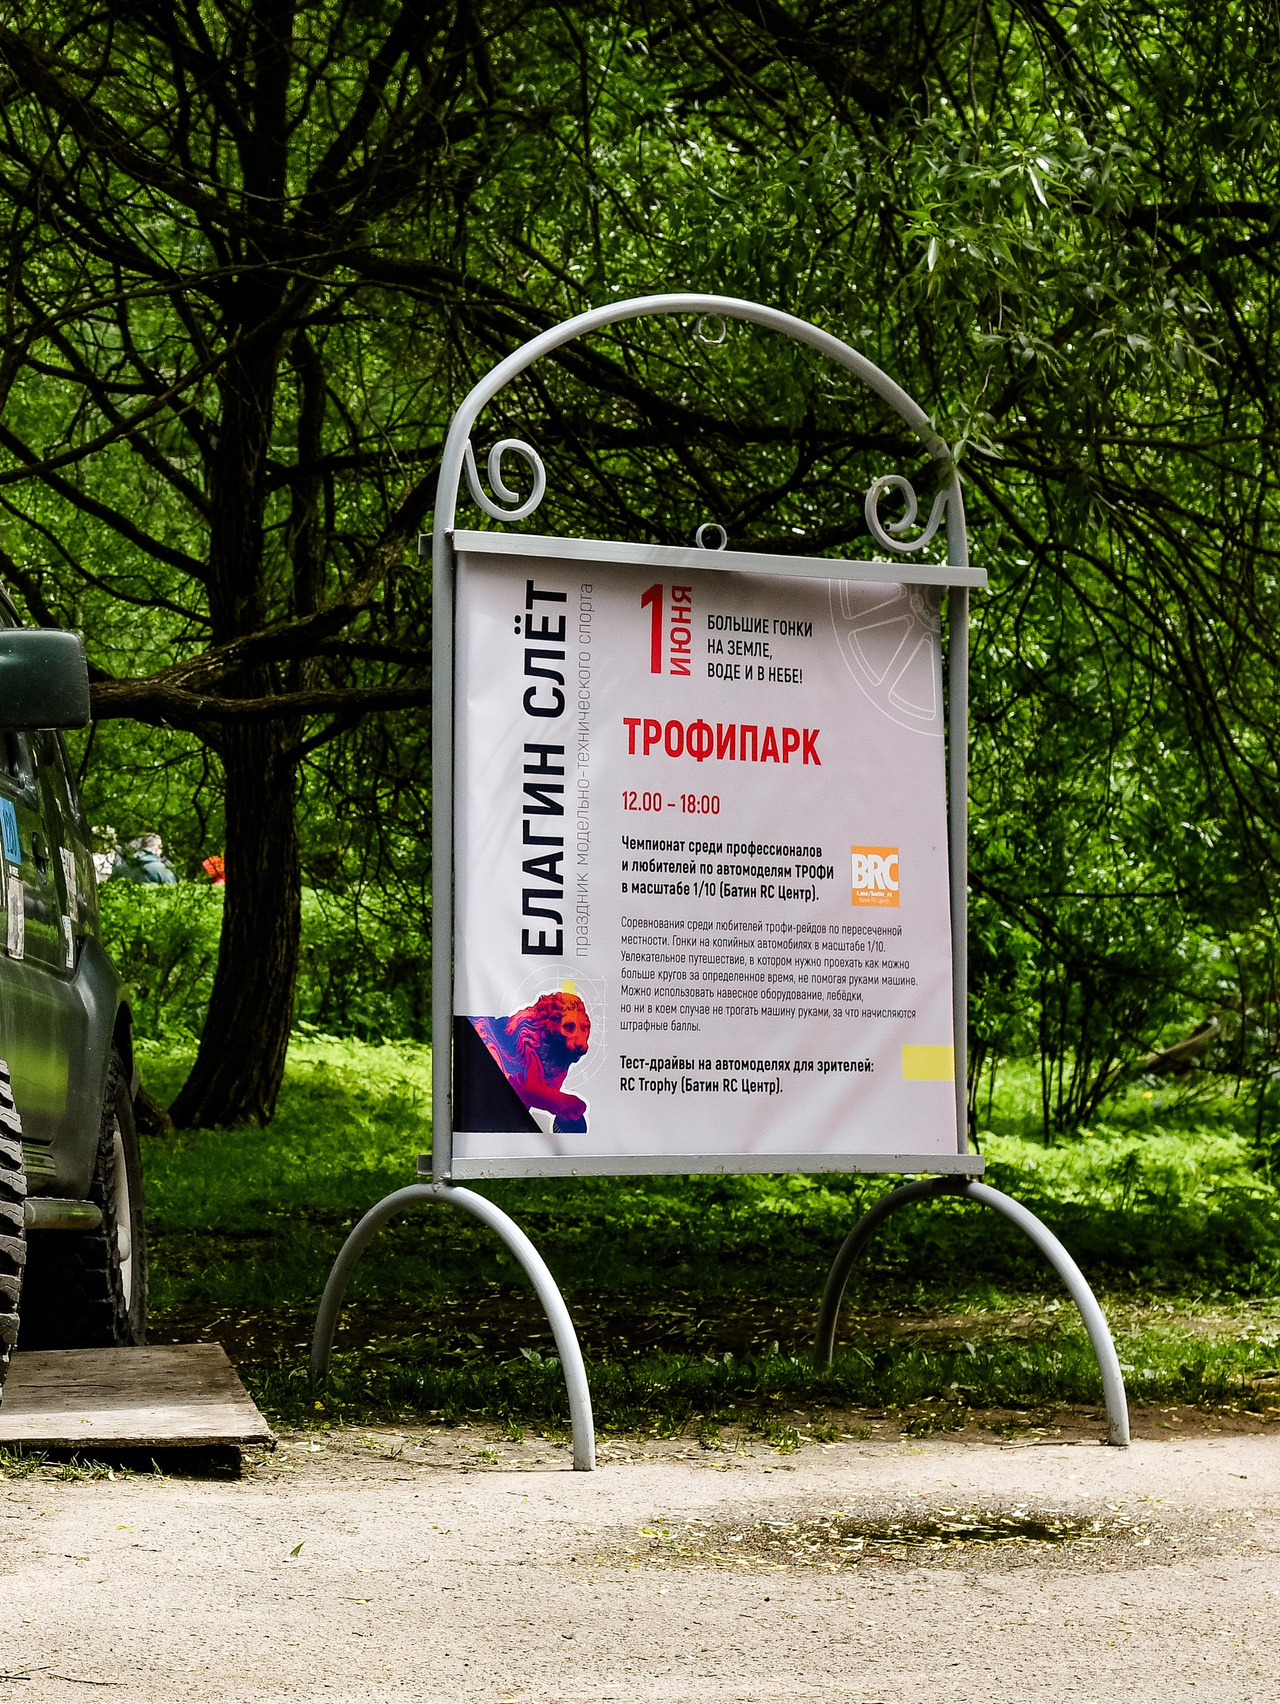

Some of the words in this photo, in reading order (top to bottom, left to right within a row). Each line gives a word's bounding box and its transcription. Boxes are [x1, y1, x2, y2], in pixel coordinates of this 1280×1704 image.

[578, 583, 595, 645] спорта
[640, 584, 664, 674] 1
[670, 585, 693, 676] ИЮНЯ
[707, 614, 770, 634] БОЛЬШИЕ
[773, 619, 814, 638] ГОНКИ
[514, 580, 567, 718] СЛЁТ
[707, 638, 724, 654] НА
[727, 639, 772, 660] ЗЕМЛЕ,
[707, 662, 740, 681] ВОДЕ
[745, 664, 753, 680] И
[757, 665, 764, 681] В
[768, 666, 802, 684] НЕБЕ!
[623, 717, 821, 765] ТРОФИПАРК
[577, 651, 592, 866] модельно-технического
[622, 790, 662, 812] 12.00
[680, 793, 720, 814] 18:00
[521, 743, 565, 956] ЕЛАГИН
[621, 835, 685, 851] Чемпионат
[688, 841, 722, 855] среди
[726, 840, 822, 858] профессионалов
[621, 860, 628, 871] и
[631, 858, 696, 874] любителей
[699, 863, 713, 874] по
[716, 864, 791, 878] автомоделям
[794, 864, 834, 880] ТРОФИ
[851, 853, 899, 891] BRC
[621, 882, 628, 893] в
[631, 880, 690, 895] масштабе
[693, 880, 716, 898] 1/10
[719, 880, 756, 899] (Батин
[760, 884, 775, 898] RC
[778, 884, 819, 903] Центр).
[576, 872, 591, 957] праздник
[621, 915, 684, 930] Соревнования
[687, 920, 713, 932] среди
[715, 919, 763, 931] любителей
[765, 921, 826, 935] трофи-рейдов
[828, 925, 839, 934] по
[841, 925, 902, 937] пересеченной
[621, 935, 669, 945] местности.
[672, 934, 697, 946] Гонки
[699, 937, 710, 947] на
[712, 936, 755, 948] копийных
[757, 937, 812, 950] автомобилях
[814, 941, 819, 950] в
[821, 940, 865, 951] масштабе
[867, 939, 885, 953] 1/10.
[620, 950, 686, 963] Увлекательное
[688, 954, 747, 966] путешествие,
[749, 956, 754, 965] в
[757, 956, 792, 968] котором
[794, 957, 821, 969] нужно
[824, 958, 863, 969] проехать
[864, 959, 879, 968] как
[881, 960, 909, 969] можно
[621, 966, 655, 979] больше
[657, 970, 687, 982] кругов
[689, 971, 699, 980] за
[702, 971, 765, 983] определенное
[767, 973, 795, 984] время,
[798, 974, 808, 983] не
[811, 974, 846, 984] помогая
[848, 975, 879, 987] руками
[881, 976, 918, 986] машине.
[620, 984, 651, 996] Можно
[654, 987, 714, 997] использовать
[716, 988, 758, 999] навесное
[760, 987, 824, 1002] оборудование,
[620, 1003, 631, 1013] но
[633, 1004, 644, 1013] ни
[647, 1004, 652, 1013] в
[655, 1004, 677, 1014] коем
[679, 1004, 710, 1017] случае
[712, 1005, 723, 1015] не
[725, 1006, 759, 1017] трогать
[761, 1006, 796, 1019] машину
[798, 1007, 830, 1019] руками,
[832, 1008, 842, 1017] за
[844, 1008, 859, 1017] что
[861, 1008, 916, 1019] начисляются
[620, 1019, 668, 1033] штрафные
[670, 1019, 701, 1031] баллы.
[619, 1054, 694, 1073] Тест-драйвы
[698, 1059, 711, 1070] на
[715, 1059, 790, 1073] автомоделях
[792, 1060, 814, 1073] для
[817, 1057, 874, 1074] зрителей:
[620, 1076, 635, 1091] RC
[638, 1076, 677, 1095] Trophy
[681, 1075, 719, 1093] (Батин
[722, 1078, 738, 1092] RC
[741, 1076, 783, 1095] Центр).
